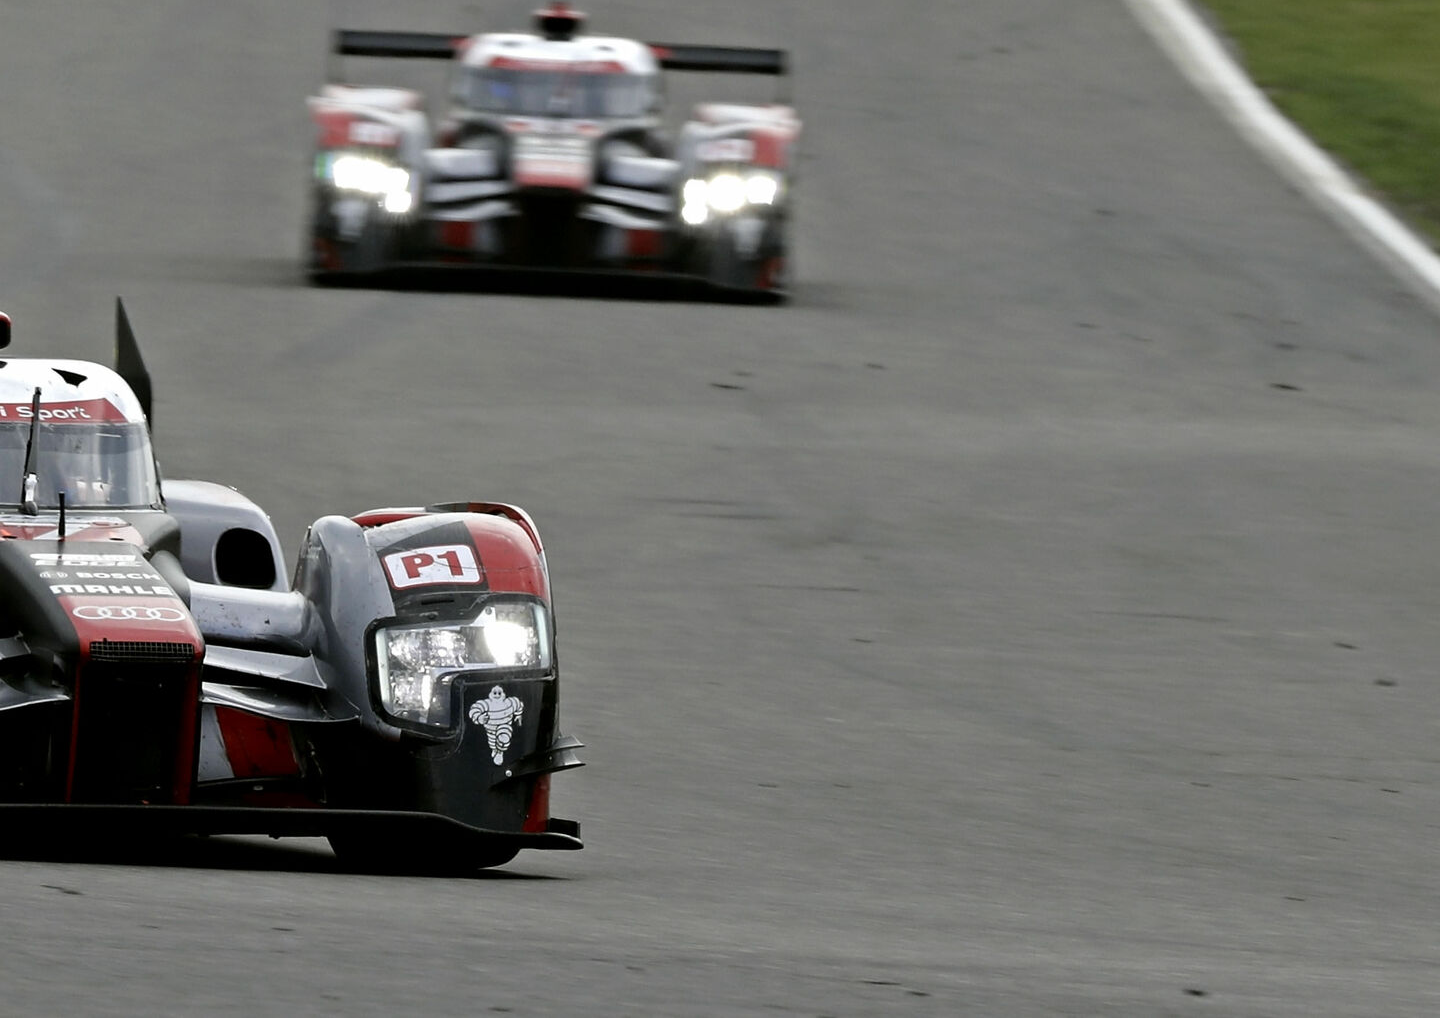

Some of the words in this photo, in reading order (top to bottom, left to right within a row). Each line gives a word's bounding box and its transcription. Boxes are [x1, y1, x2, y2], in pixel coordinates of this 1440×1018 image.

[15, 405, 91, 420] Sport
[401, 550, 464, 579] P1
[76, 571, 161, 581] BOSCH
[48, 584, 175, 596] MAHLE
